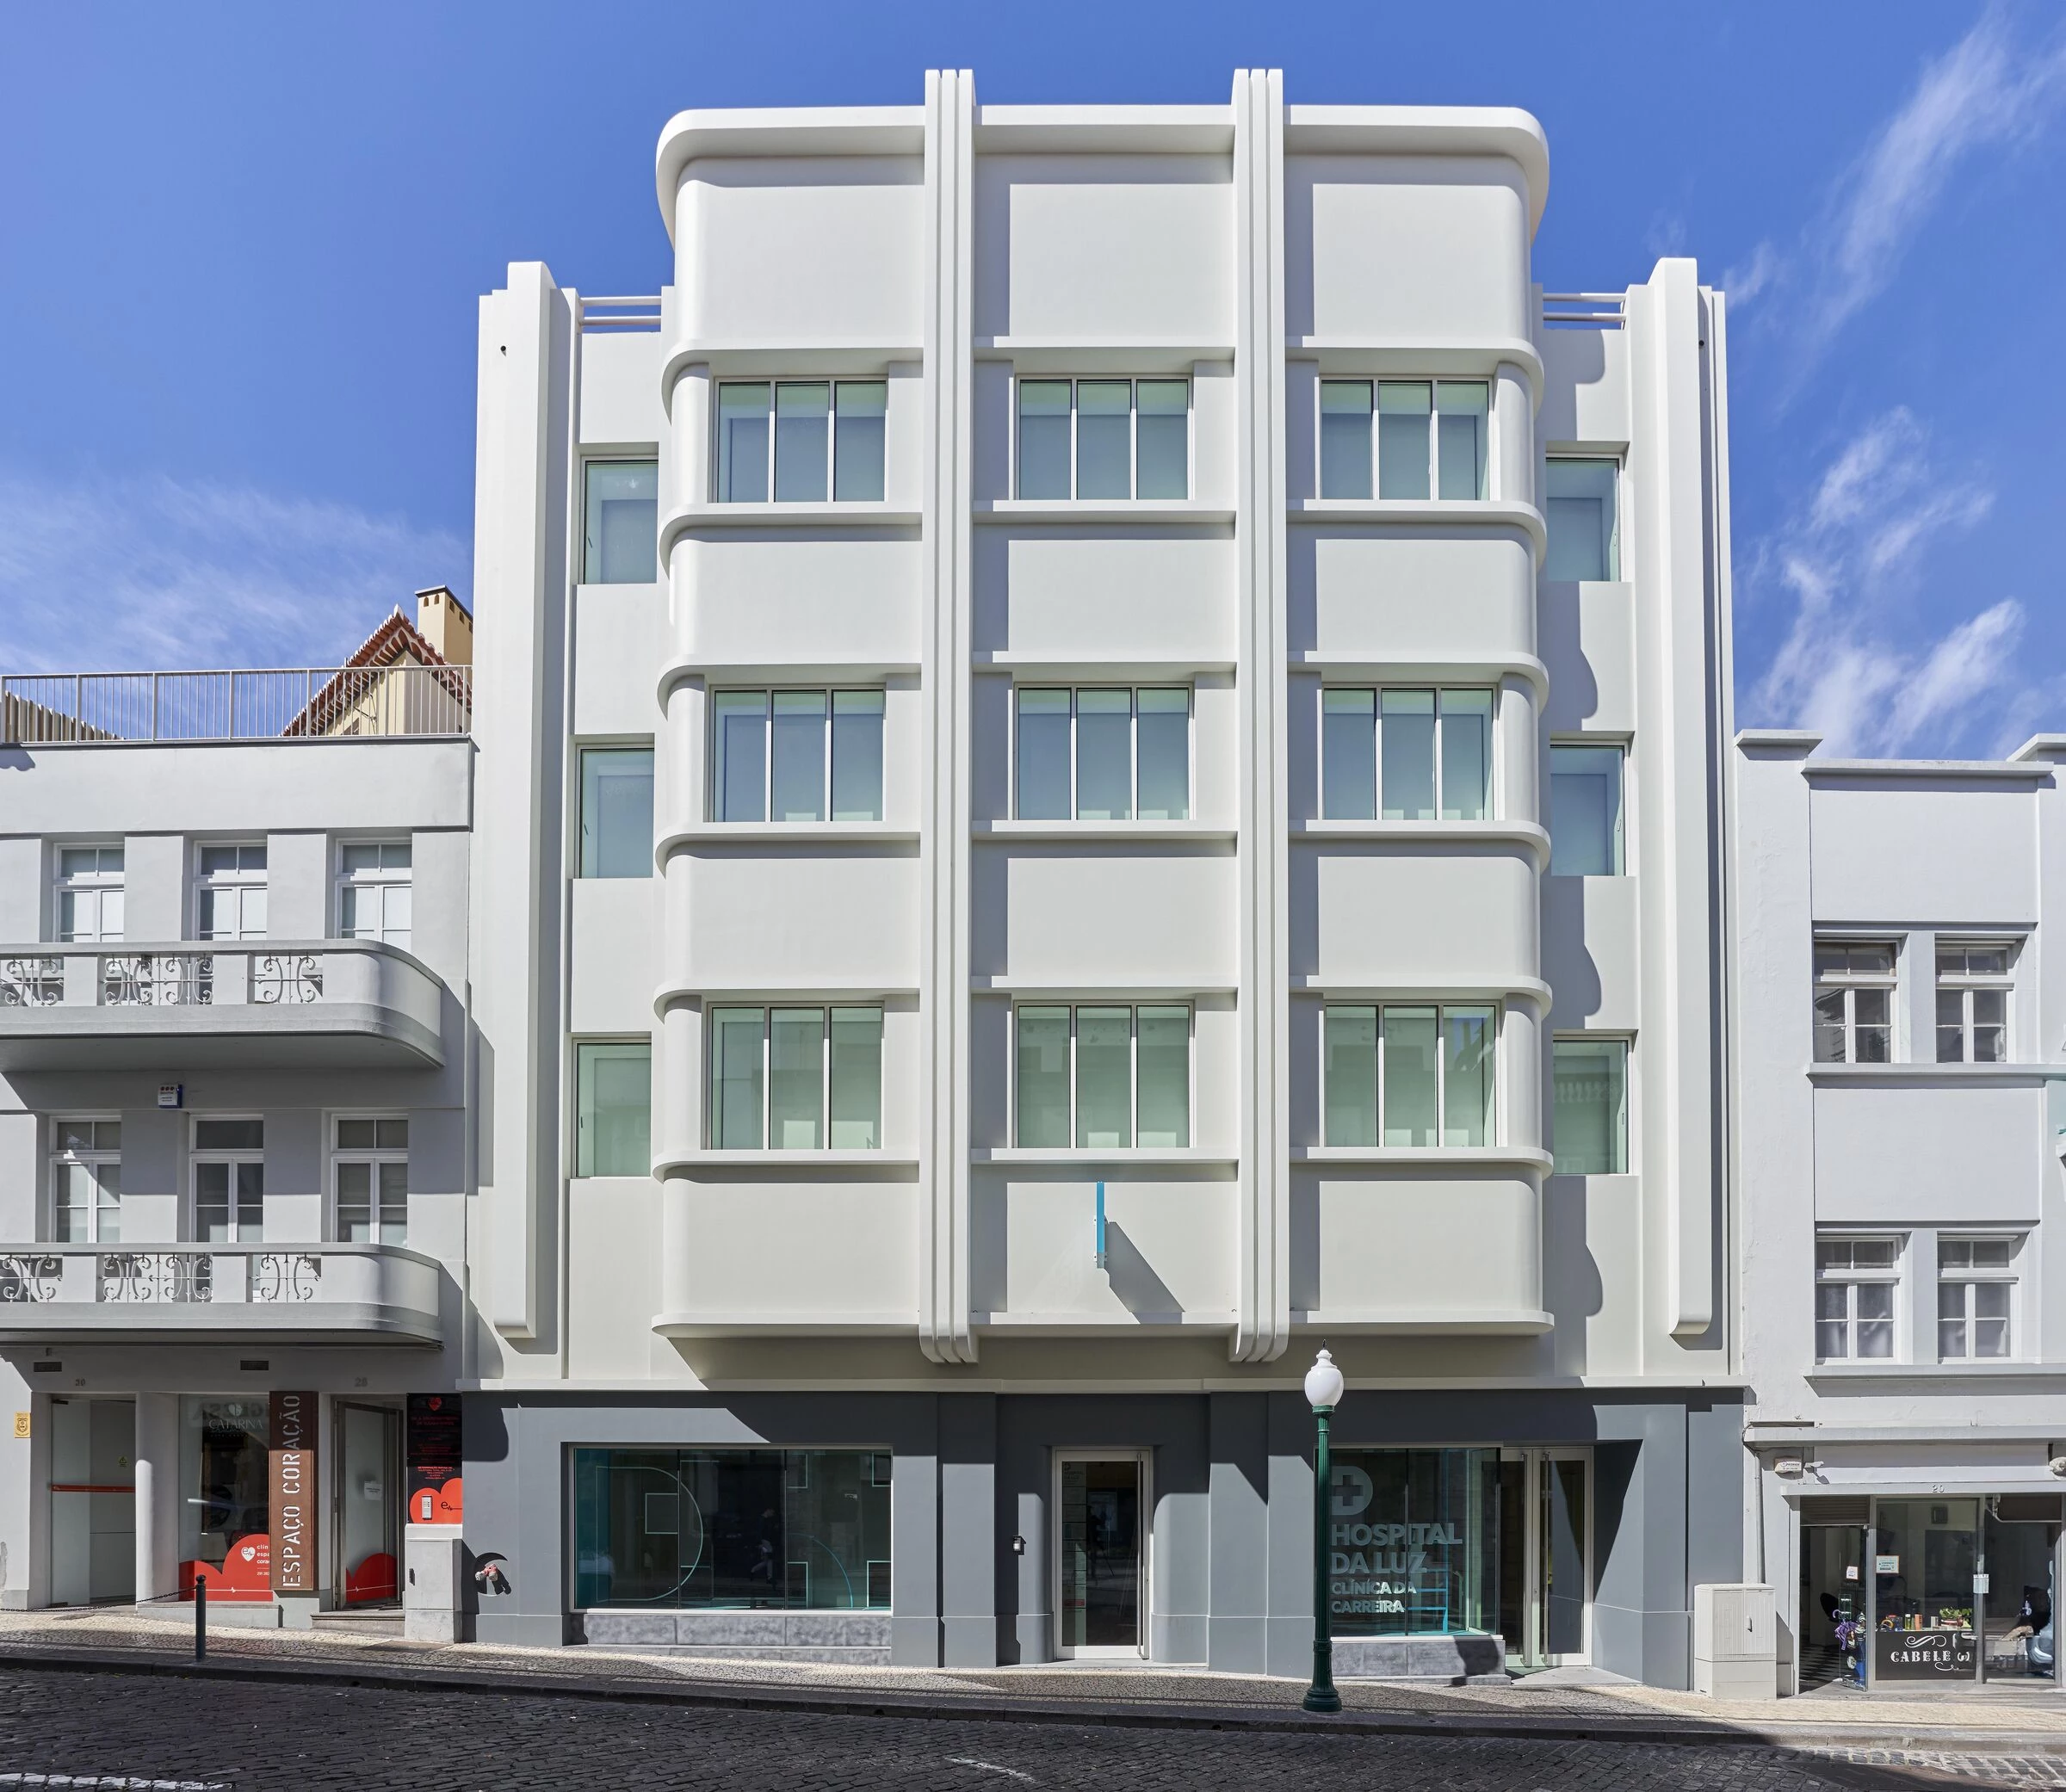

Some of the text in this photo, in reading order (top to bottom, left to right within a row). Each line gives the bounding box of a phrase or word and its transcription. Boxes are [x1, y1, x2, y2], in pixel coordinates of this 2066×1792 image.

[208, 1418, 263, 1430] CATARINA
[279, 1395, 304, 1586] ESPAÇO CORAÇÃO
[1331, 1523, 1463, 1546] HOSPITAL
[1331, 1550, 1428, 1574] DA LUZ
[1394, 1581, 1418, 1595] DA
[1331, 1598, 1406, 1614] CARREIRA
[1890, 1650, 1952, 1663] CABELE
